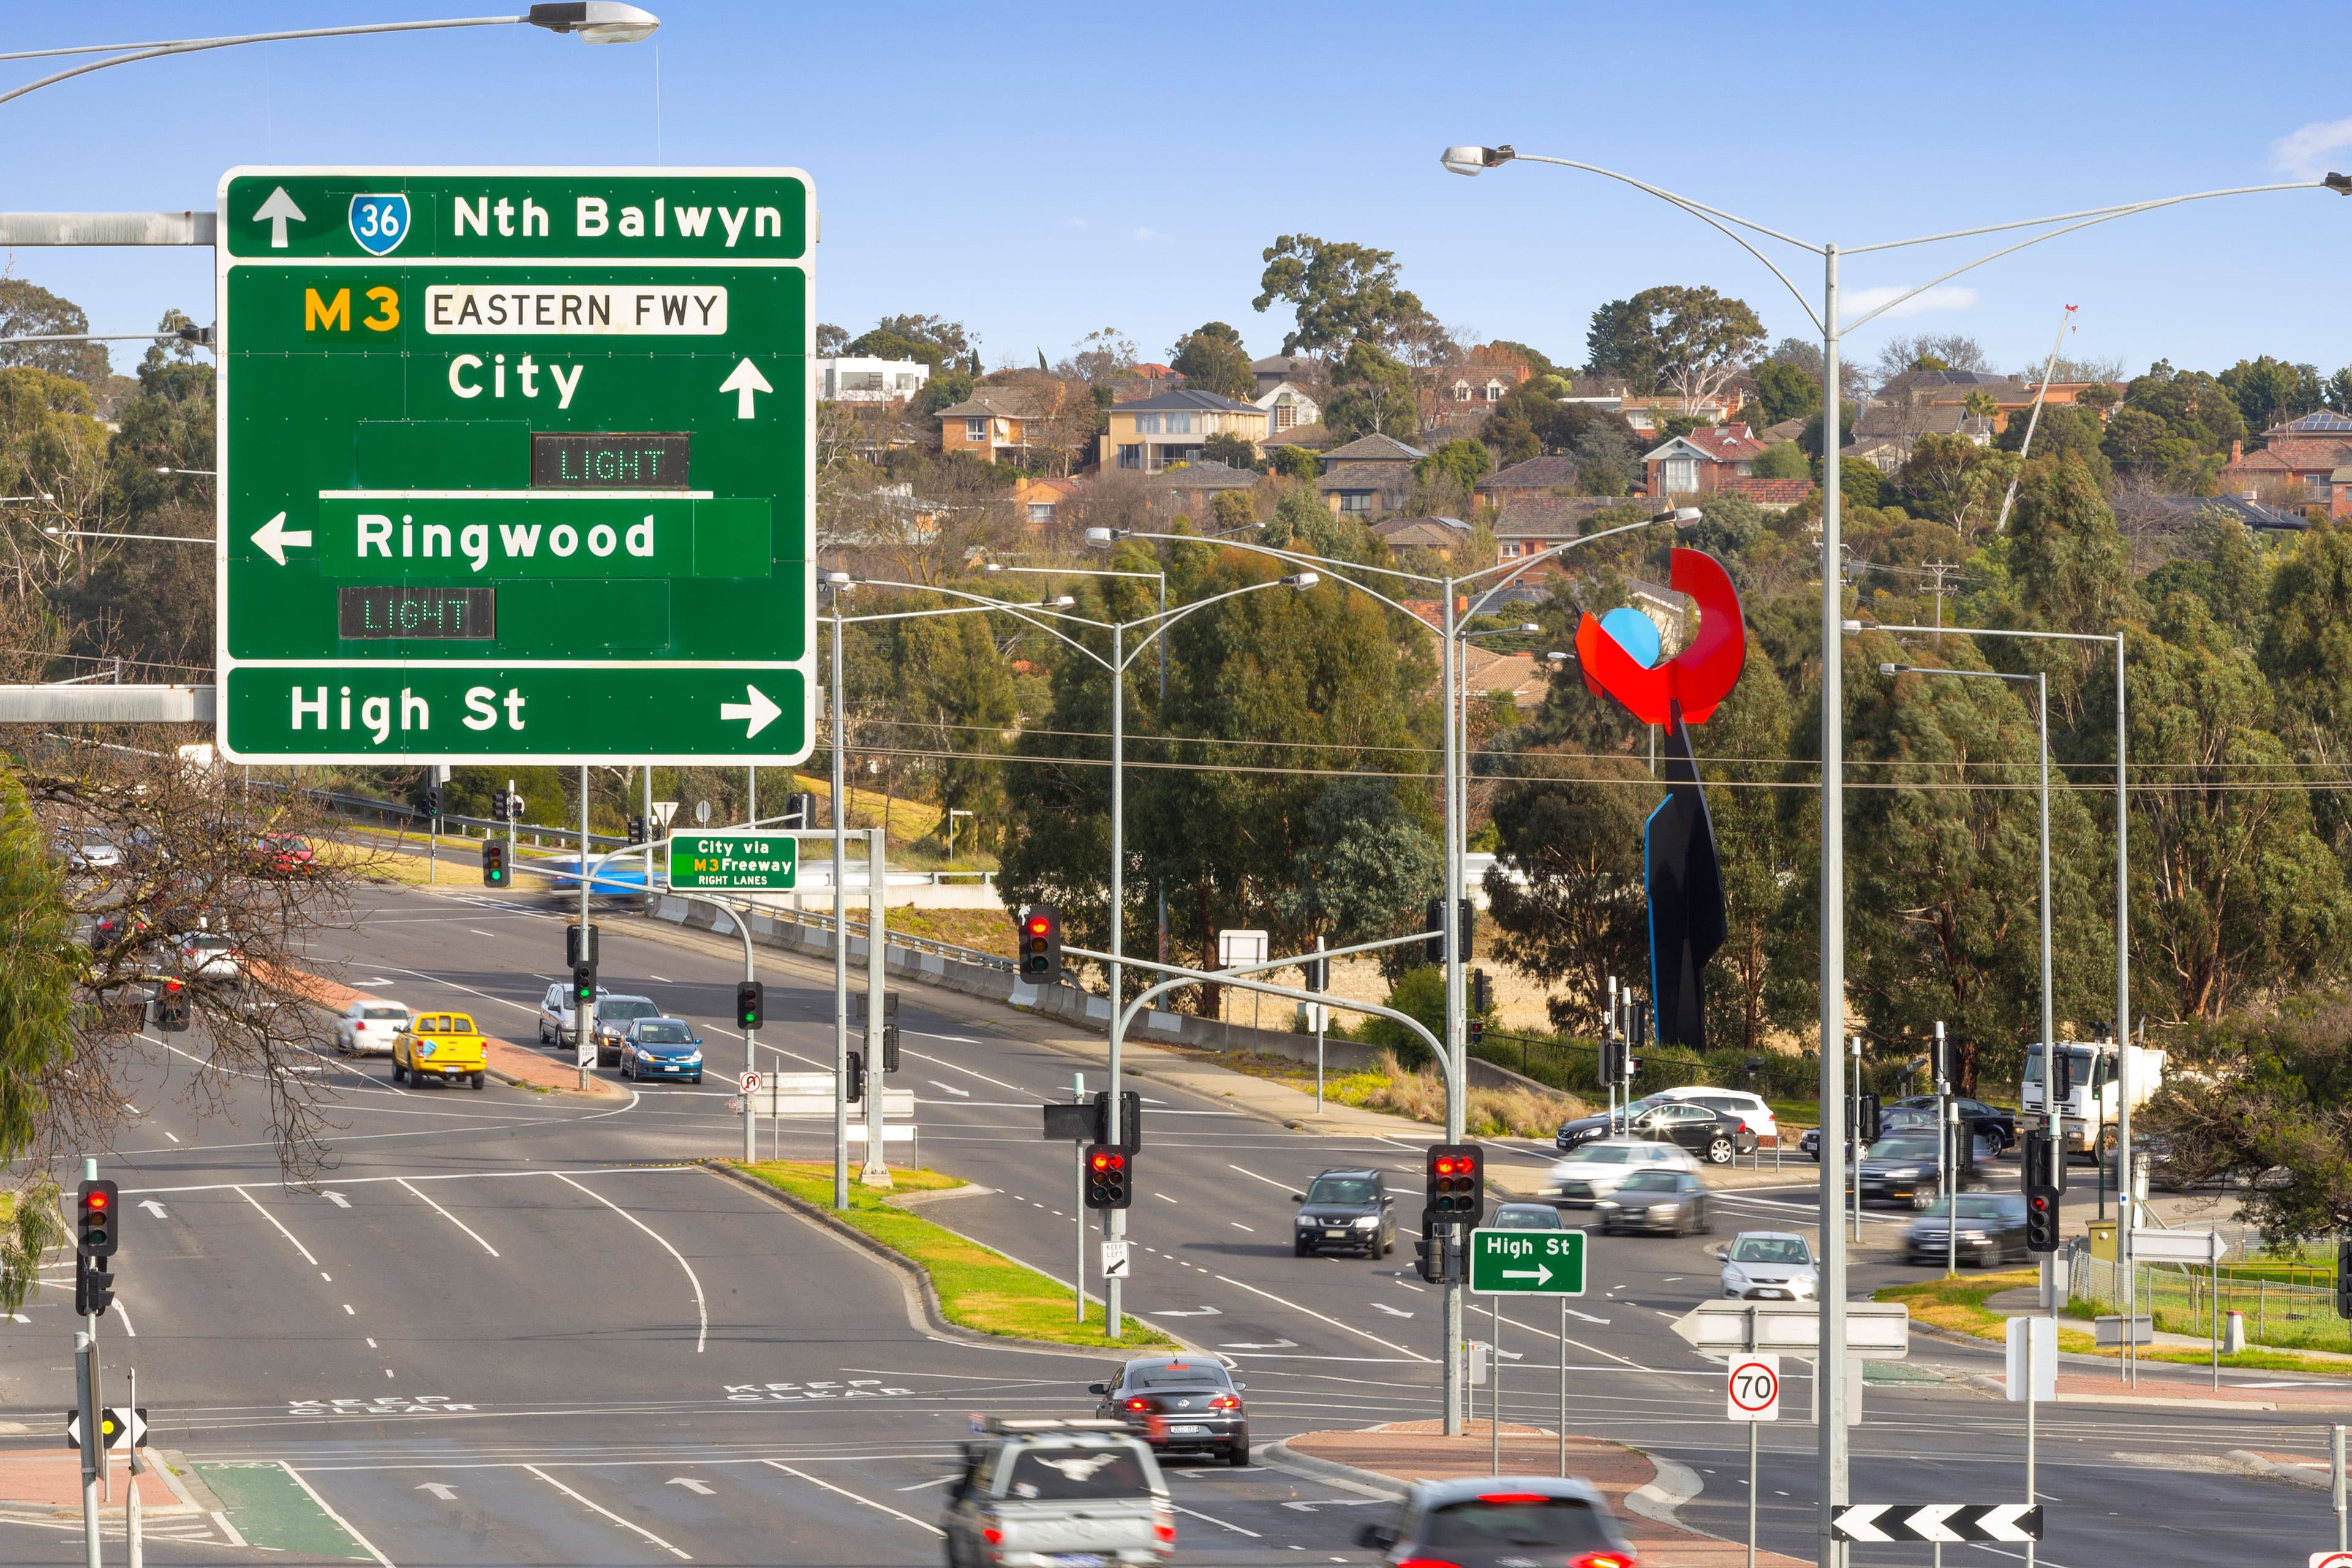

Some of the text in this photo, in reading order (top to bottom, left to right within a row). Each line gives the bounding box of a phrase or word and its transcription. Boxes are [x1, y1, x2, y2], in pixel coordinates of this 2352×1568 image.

[360, 196, 782, 247] 36 Nth Balwyn
[306, 286, 718, 332] M3 EASTERN FWY
[448, 353, 584, 410] City
[561, 450, 665, 480] LIGHT
[356, 514, 654, 573] Ringwood
[365, 600, 469, 630] LIGHT
[291, 685, 526, 745] High St
[698, 840, 769, 857] City via
[694, 858, 792, 875] M3 Freeway
[698, 875, 768, 886] RIGHT LANES
[1487, 1237, 1570, 1259] High St
[723, 1379, 883, 1393] KEEP
[726, 1387, 916, 1401] CLEAR
[1737, 1375, 1771, 1399] 70
[288, 1395, 451, 1407] KEEP
[288, 1403, 478, 1415] CLEAR
